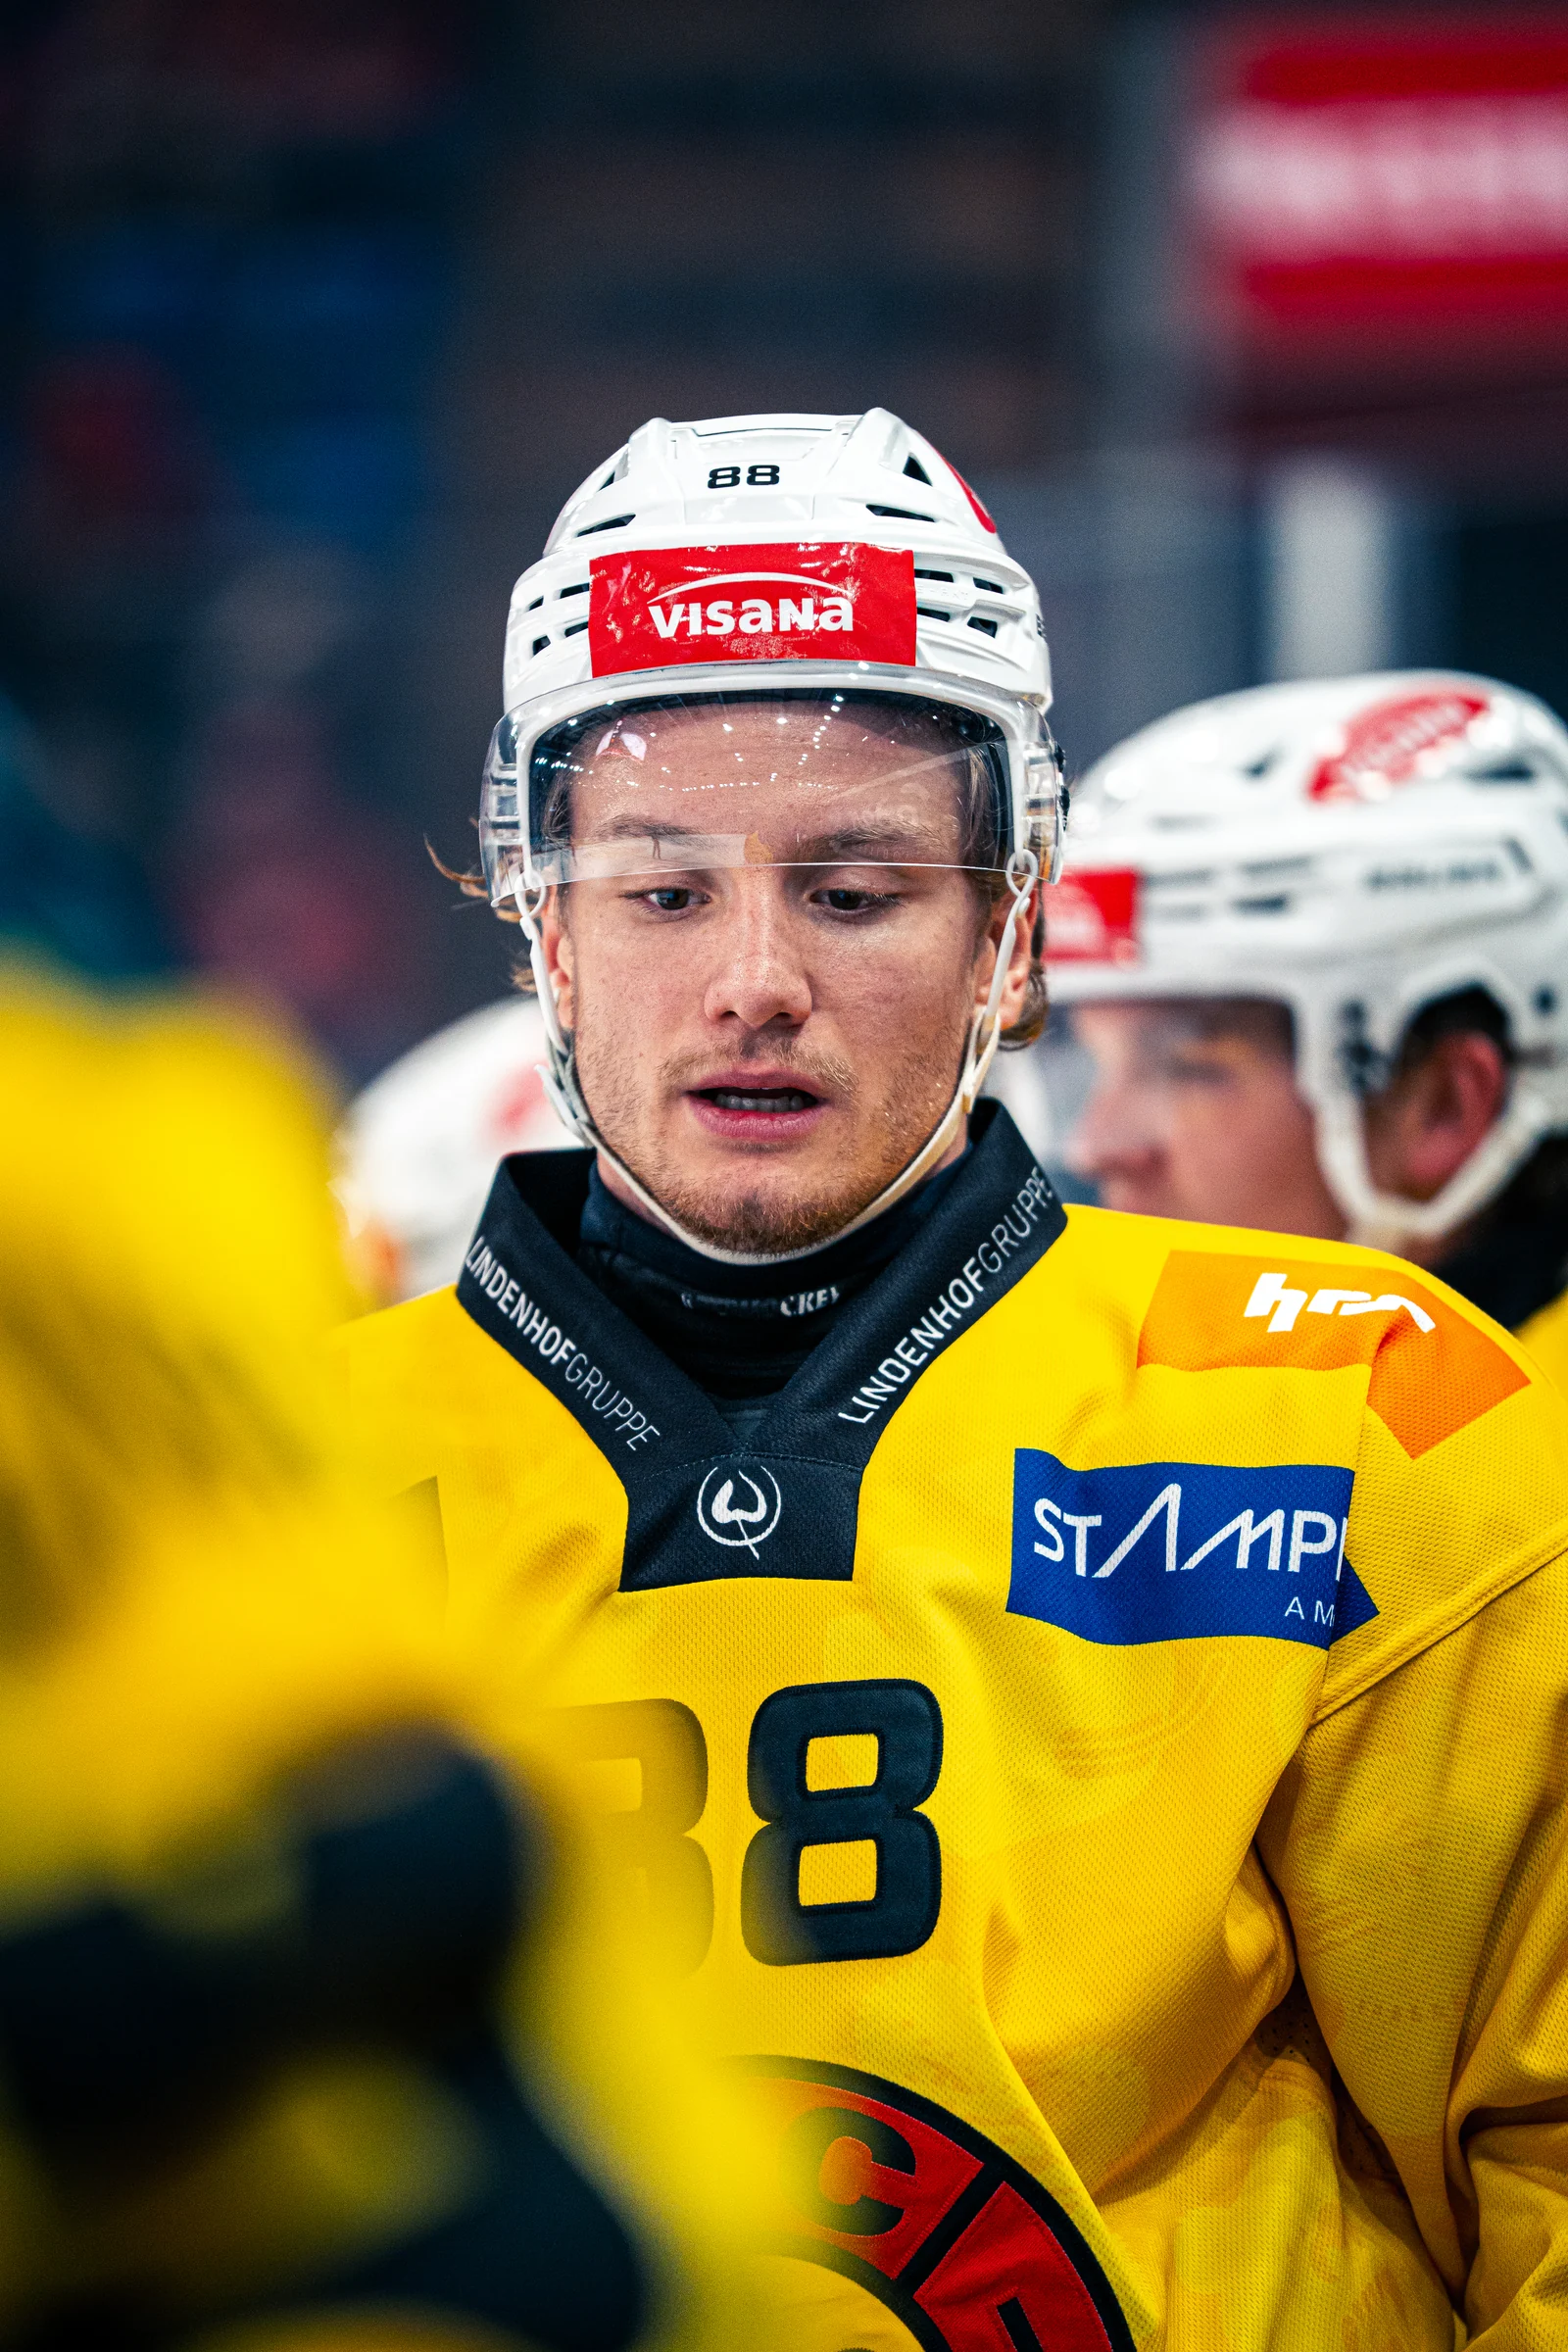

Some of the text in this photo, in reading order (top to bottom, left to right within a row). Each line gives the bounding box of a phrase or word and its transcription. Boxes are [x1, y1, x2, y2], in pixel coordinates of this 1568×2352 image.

[707, 464, 781, 489] 88
[465, 1235, 662, 1451] LINDENHOFGRUPPE
[838, 1165, 1054, 1424] LINDENHOFGRUPPE
[1284, 1595, 1336, 1628] AM
